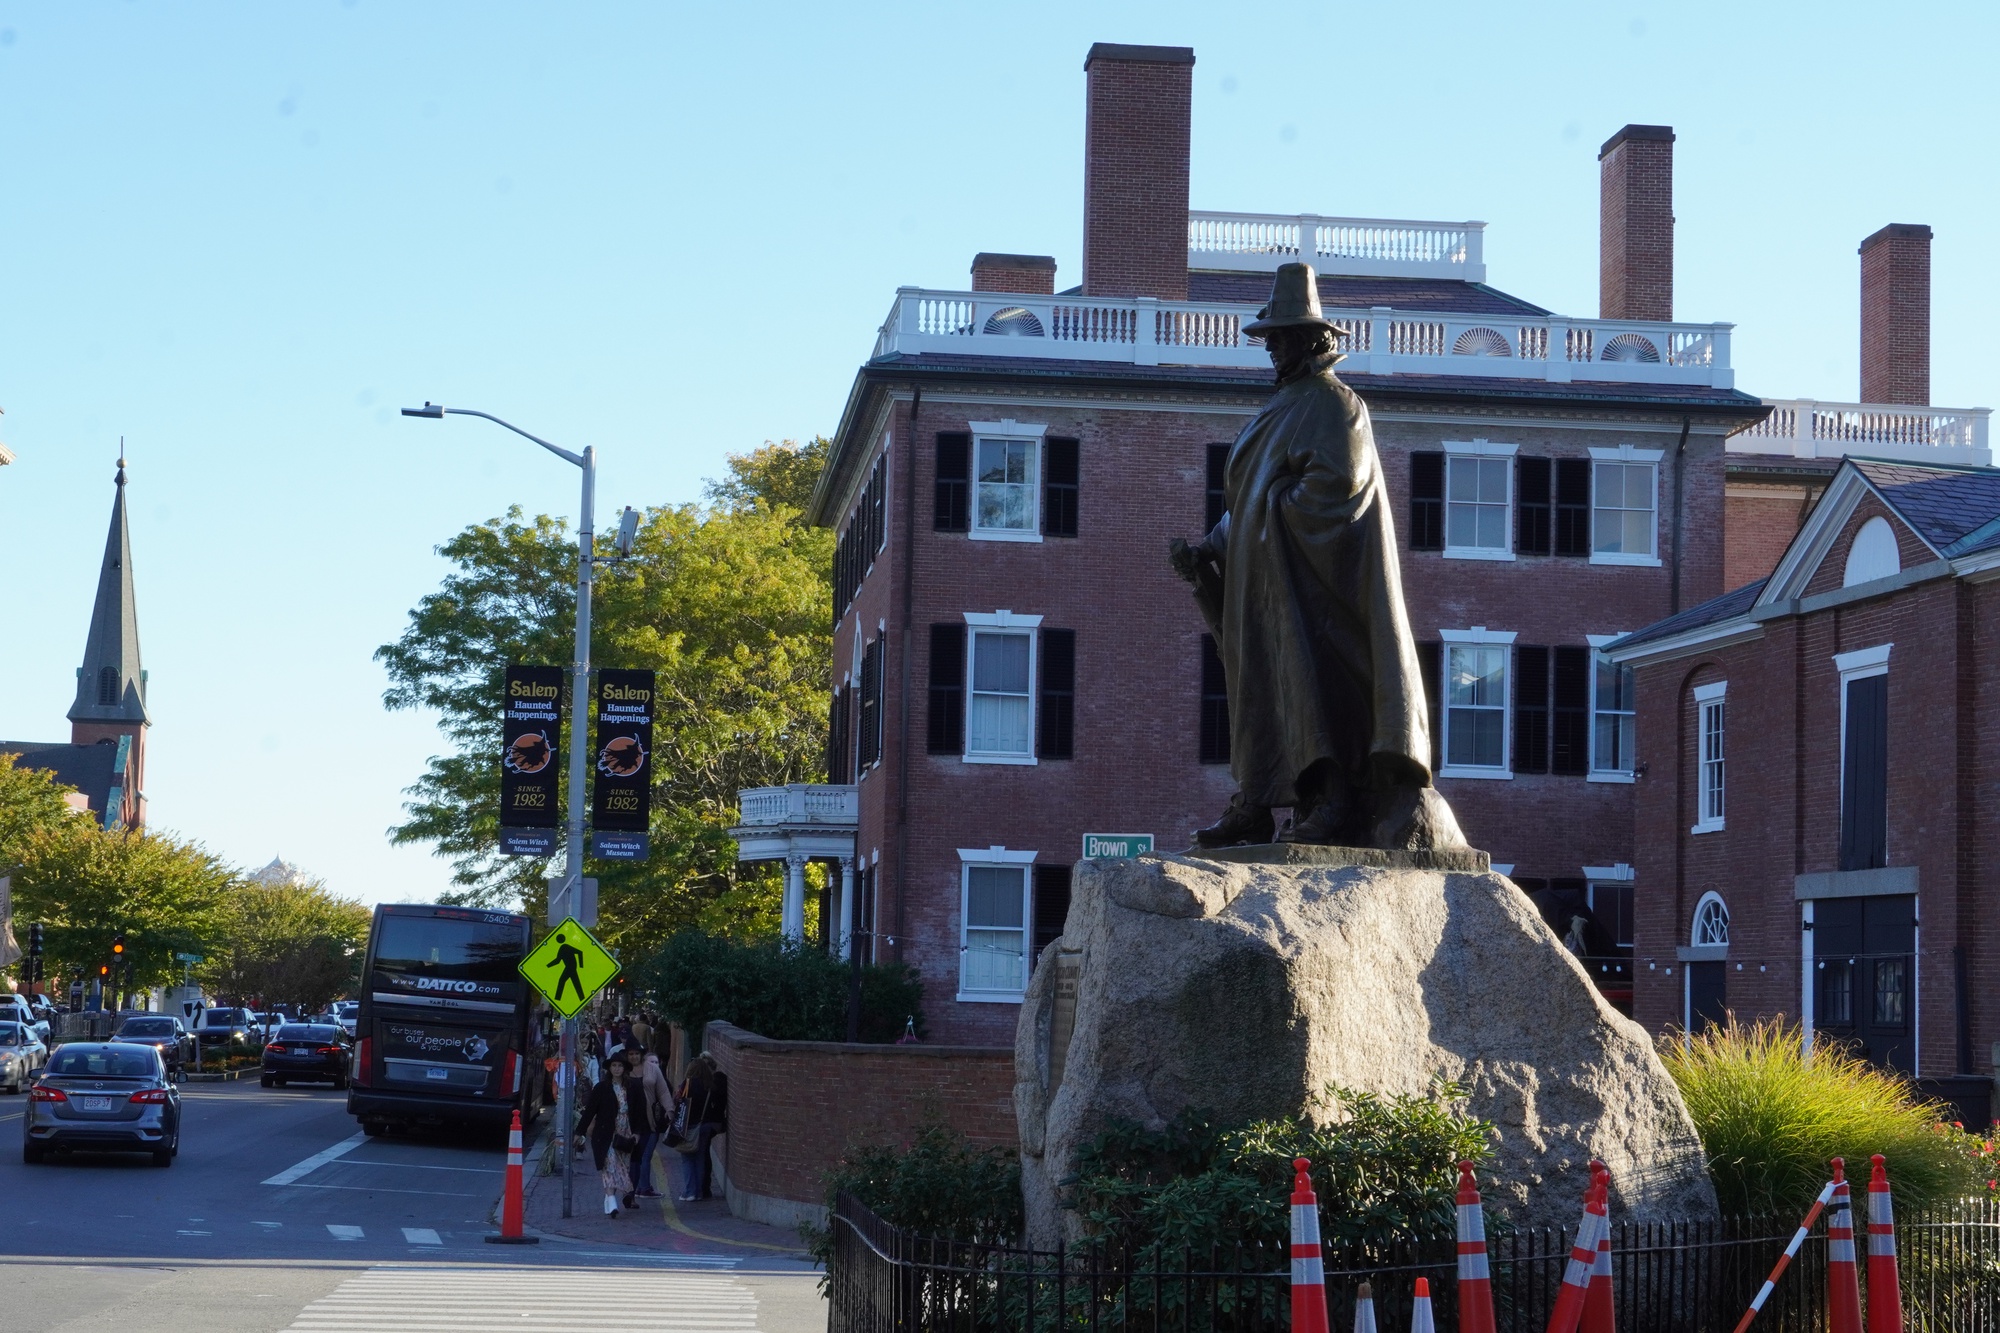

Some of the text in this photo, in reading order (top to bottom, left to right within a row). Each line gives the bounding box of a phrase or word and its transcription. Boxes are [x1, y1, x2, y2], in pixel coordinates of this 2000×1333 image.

[510, 680, 558, 700] Salem
[602, 683, 651, 703] Salem
[514, 701, 552, 710] Haunted
[607, 704, 645, 713] Haunted
[507, 710, 557, 721] Happenings
[600, 713, 650, 724] Happenings
[513, 793, 545, 807] 1982
[606, 796, 639, 810] 1982
[1089, 837, 1128, 857] Brown
[483, 914, 510, 924] 75405
[392, 978, 500, 994] www.DATTCO.com
[404, 1028, 425, 1036] buses
[406, 1035, 462, 1048] our people
